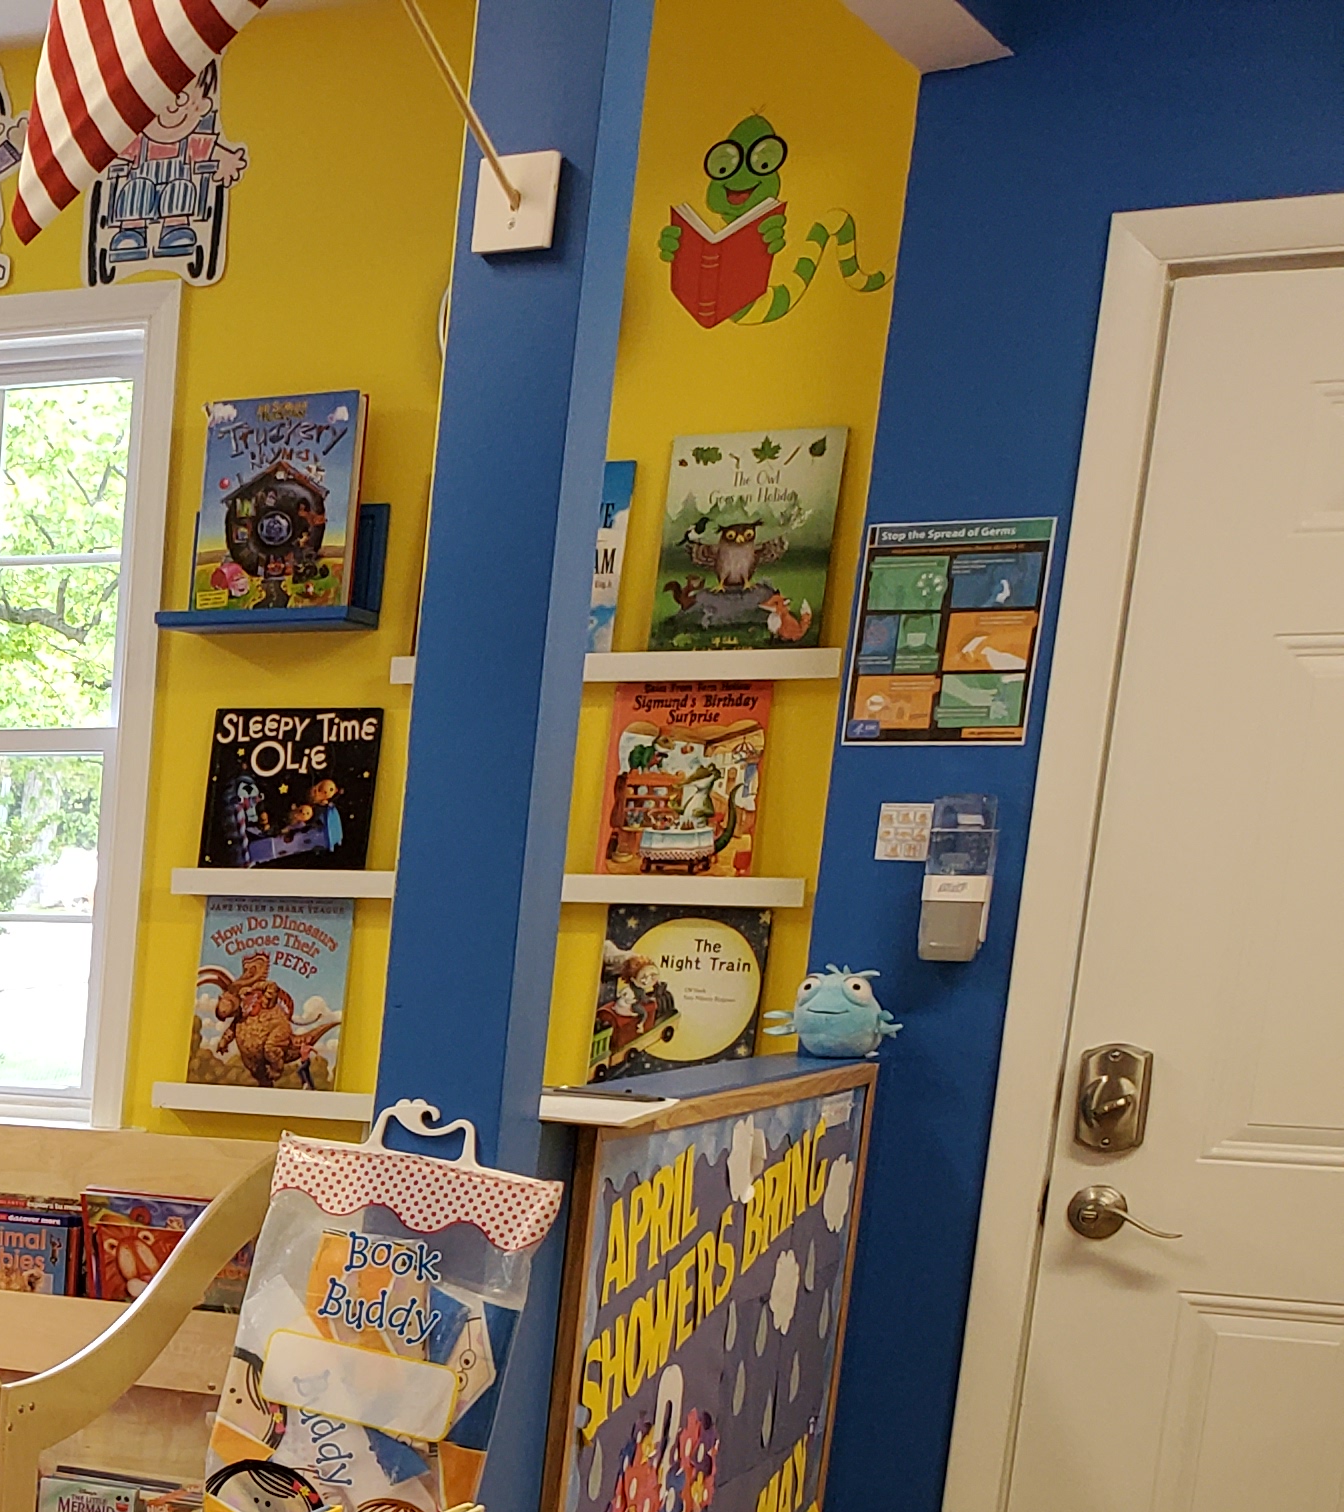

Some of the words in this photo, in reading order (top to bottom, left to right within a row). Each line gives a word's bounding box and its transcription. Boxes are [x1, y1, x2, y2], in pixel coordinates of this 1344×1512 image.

[733, 471, 751, 487] The
[756, 470, 780, 486] Owl
[881, 530, 906, 542] Stop
[908, 529, 926, 539] the
[927, 528, 965, 541] Spread
[967, 527, 980, 537] of
[981, 526, 1017, 537] Germs
[633, 694, 696, 712] Sigmund's
[703, 693, 759, 710] Birthday
[666, 709, 720, 726] Surprise
[210, 923, 243, 948] How
[246, 916, 269, 931] Do
[271, 914, 339, 952] Dinosaurs
[225, 933, 280, 956] Choose
[283, 932, 321, 958] Their
[694, 938, 722, 953] The
[273, 951, 318, 979] PETS?
[660, 955, 701, 972] Night
[710, 957, 751, 972] Train
[601, 1142, 699, 1308] APRIL
[345, 1230, 443, 1283] Book
[580, 1212, 737, 1448] SHOWERS
[739, 1117, 828, 1278] BRING
[317, 1276, 442, 1345] Buddy
